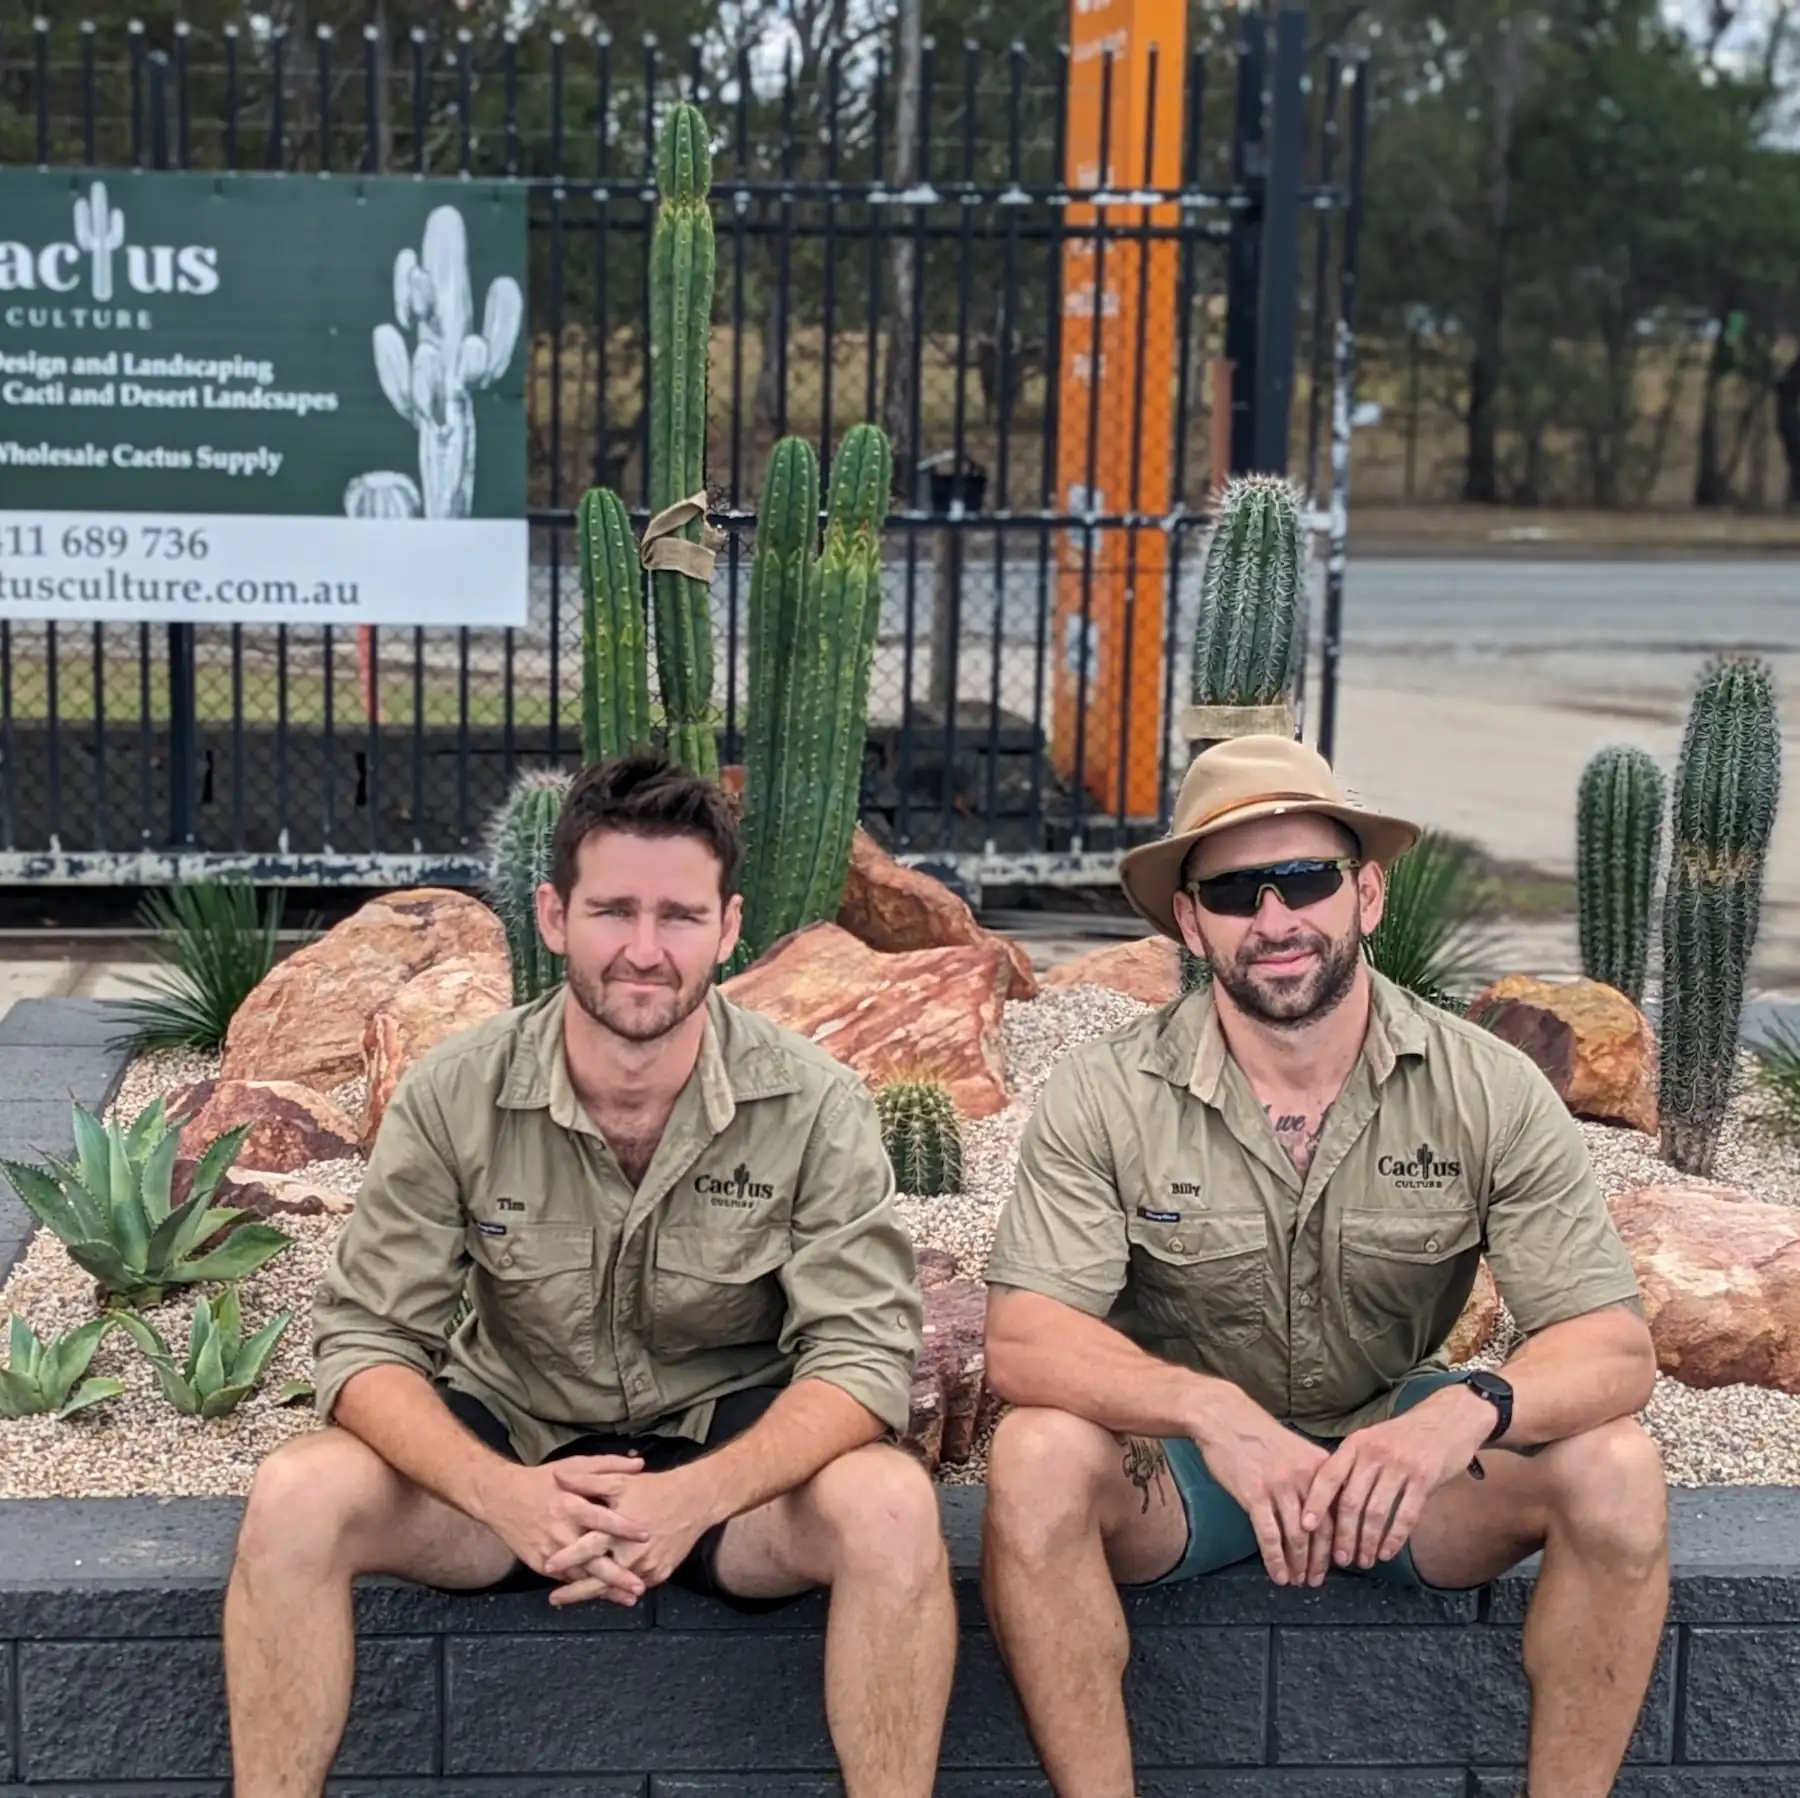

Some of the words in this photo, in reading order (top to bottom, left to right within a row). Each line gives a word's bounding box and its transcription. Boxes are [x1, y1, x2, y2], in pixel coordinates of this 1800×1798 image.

[5, 306, 152, 331] CULTURE
[72, 351, 118, 376] and
[123, 352, 275, 386] Landscaping
[2, 380, 65, 406] Cacti
[69, 382, 115, 407] and
[120, 382, 198, 409] Desert
[112, 443, 192, 469] Cactus
[196, 445, 284, 476] Supply
[0, 524, 47, 558] 11
[61, 524, 128, 560] 689
[140, 526, 209, 561] 736
[1378, 1143, 1461, 1180] Cactus
[694, 1162, 774, 1200] Cactus
[1171, 1182, 1201, 1197] Billy
[496, 1197, 525, 1211] Tim
